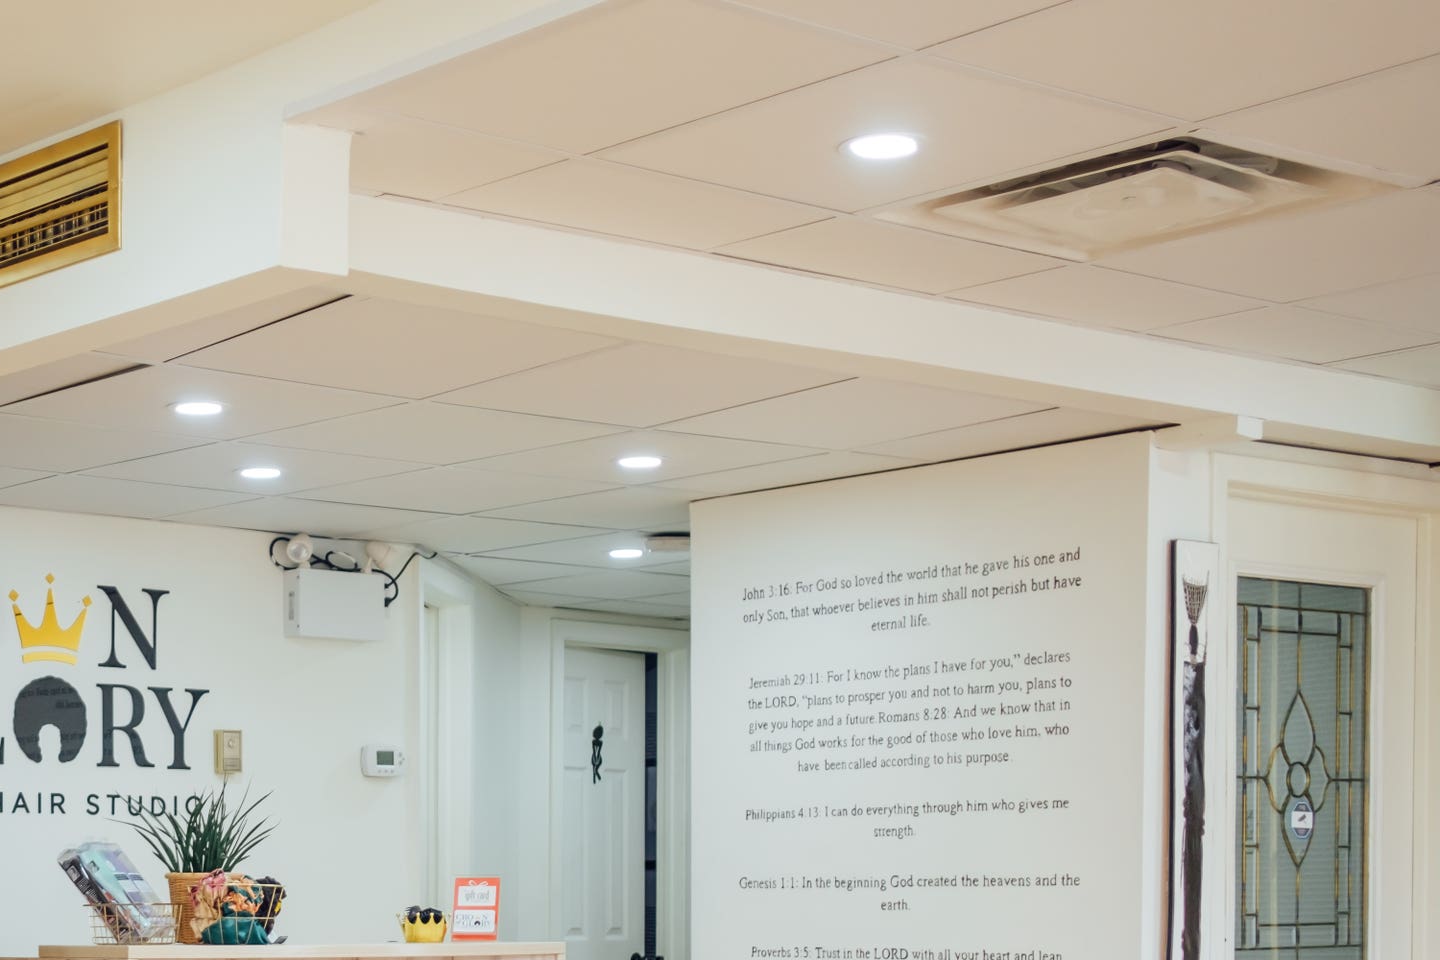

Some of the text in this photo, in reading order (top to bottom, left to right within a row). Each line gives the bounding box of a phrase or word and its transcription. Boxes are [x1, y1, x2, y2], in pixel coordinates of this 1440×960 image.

[742, 545, 1080, 601] John For God loved the world that gave his one and
[742, 609, 764, 624] only
[790, 605, 809, 618] that
[811, 602, 855, 616] whoever
[857, 596, 900, 611] believes
[916, 591, 938, 604] him
[941, 585, 967, 602] shall
[971, 586, 989, 598] not
[991, 578, 1027, 599] perish
[1030, 577, 1050, 592] but
[1052, 575, 1082, 589] have
[870, 615, 906, 631] eternal
[748, 650, 1070, 689] Jeremiah For know the plans have for declares
[747, 676, 1056, 710] the prosper you and not harm plans
[748, 699, 1056, 734] give you hope and And know that
[763, 722, 1071, 753] things God works for the good those who love who
[797, 751, 962, 772] have been called according his
[745, 798, 1048, 823] Philippians everything through him who gives
[738, 876, 777, 889] Genesis
[814, 876, 831, 888] the
[832, 875, 887, 891] beginning
[889, 873, 914, 888] God
[915, 874, 957, 887] created
[960, 874, 979, 888] the
[982, 873, 1031, 887] heavens
[1034, 872, 1057, 886] and
[1060, 872, 1080, 886] the
[750, 945, 791, 958] Proverbs
[814, 946, 842, 959] Trust
[855, 947, 870, 959] the
[873, 947, 908, 960] LORD
[909, 948, 934, 960] with
[935, 948, 950, 960] all
